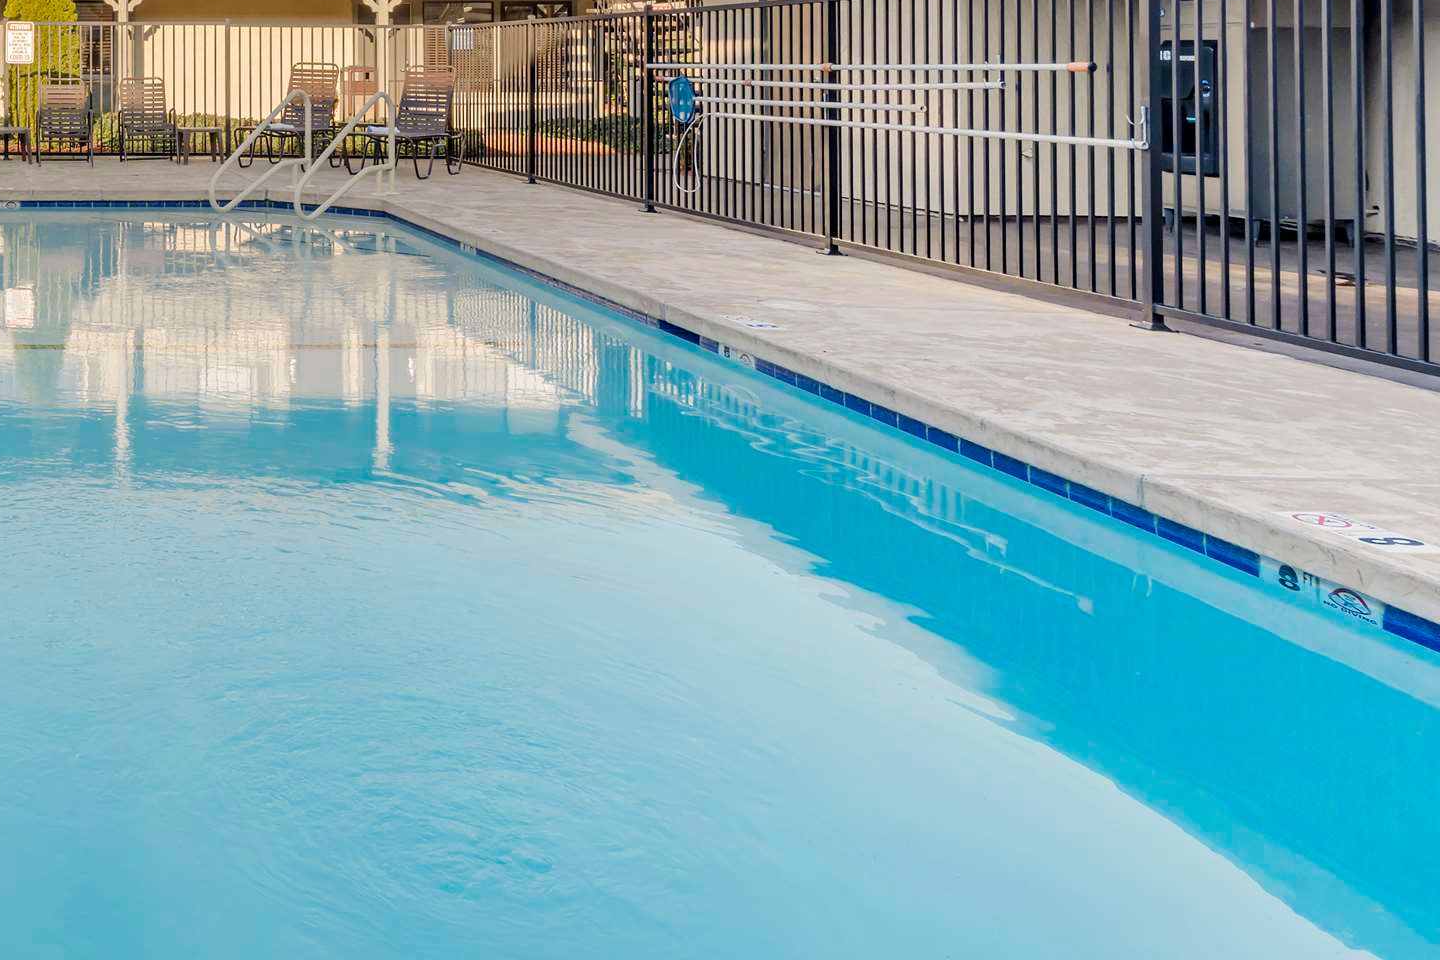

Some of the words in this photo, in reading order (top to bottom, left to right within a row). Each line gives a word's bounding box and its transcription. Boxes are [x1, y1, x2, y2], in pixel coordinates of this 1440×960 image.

[1278, 564, 1301, 591] 8
[1323, 600, 1339, 610] NO
[1341, 608, 1378, 625] DIVING
